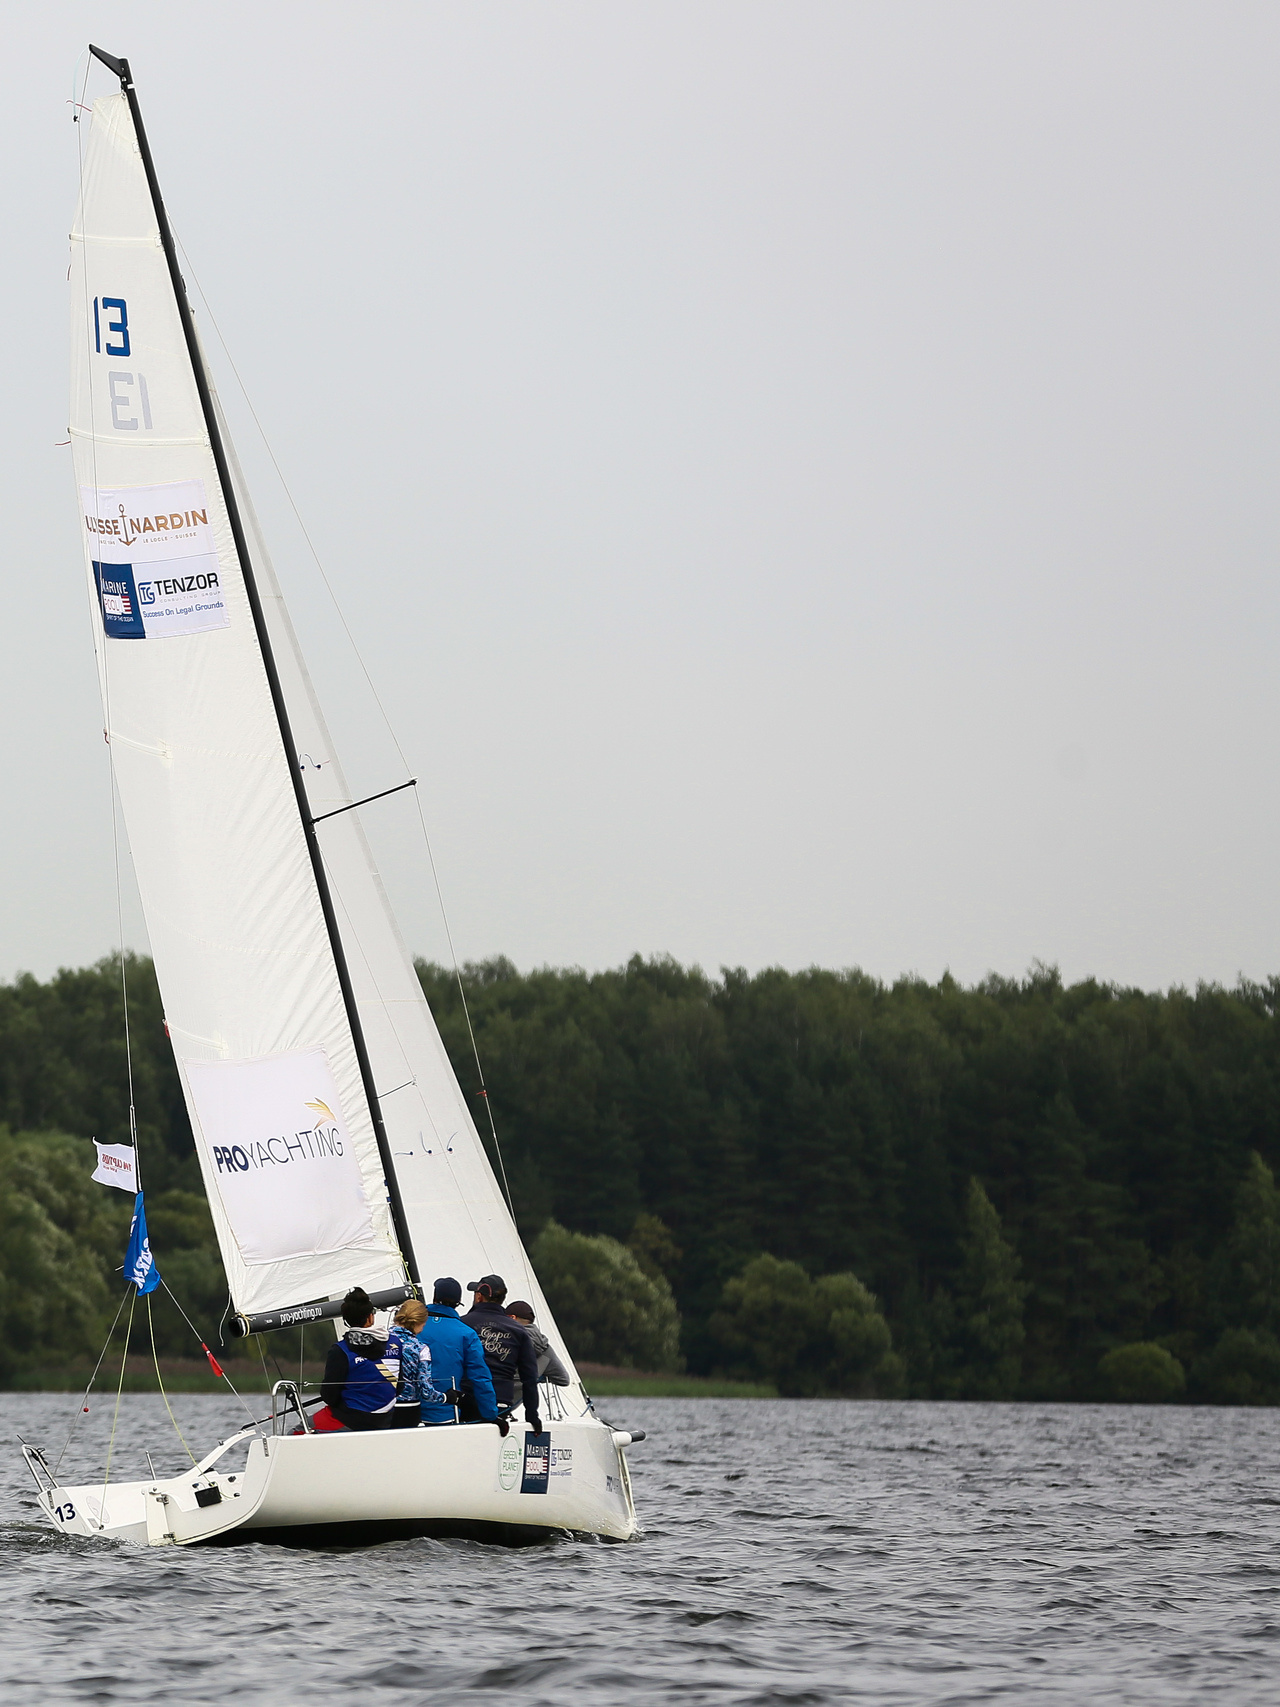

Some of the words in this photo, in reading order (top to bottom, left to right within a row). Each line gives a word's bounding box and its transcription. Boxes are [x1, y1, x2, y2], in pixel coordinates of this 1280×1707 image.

[94, 296, 131, 357] 13
[129, 508, 209, 534] NARDIN
[175, 531, 197, 539] SUISSE
[154, 572, 220, 596] TENZOR
[142, 610, 164, 618] Success
[165, 608, 175, 616] On
[175, 605, 194, 615] Legal
[195, 601, 224, 611] Grounds
[213, 1127, 344, 1173] PROYACHTING
[280, 1306, 322, 1326] pro-yachting.ru
[477, 1326, 512, 1343] Copa
[485, 1341, 512, 1362] Rey
[526, 1444, 548, 1457] MARINE
[503, 1461, 519, 1471] PLANET
[526, 1461, 541, 1472] POOL
[55, 1502, 76, 1523] 13
